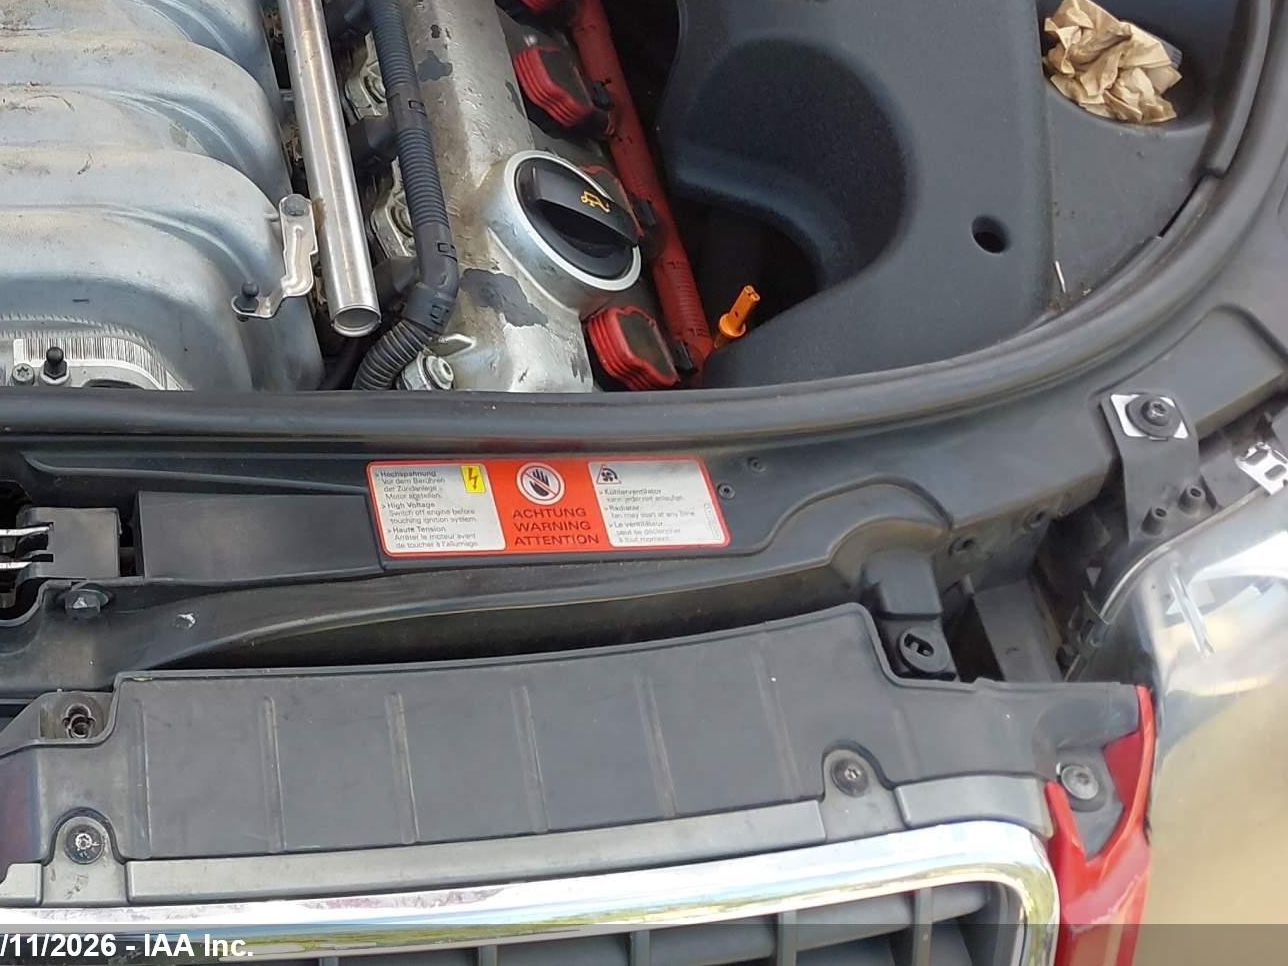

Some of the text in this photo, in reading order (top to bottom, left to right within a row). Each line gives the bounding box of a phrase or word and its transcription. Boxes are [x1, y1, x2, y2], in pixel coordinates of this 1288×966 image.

[387, 501, 436, 510] High Voltage
[452, 507, 476, 515] before
[513, 507, 587, 518] ACHTUNG
[392, 525, 446, 534] Haute Tension
[514, 520, 591, 532] WARNING
[515, 534, 600, 546] ATTENTION
